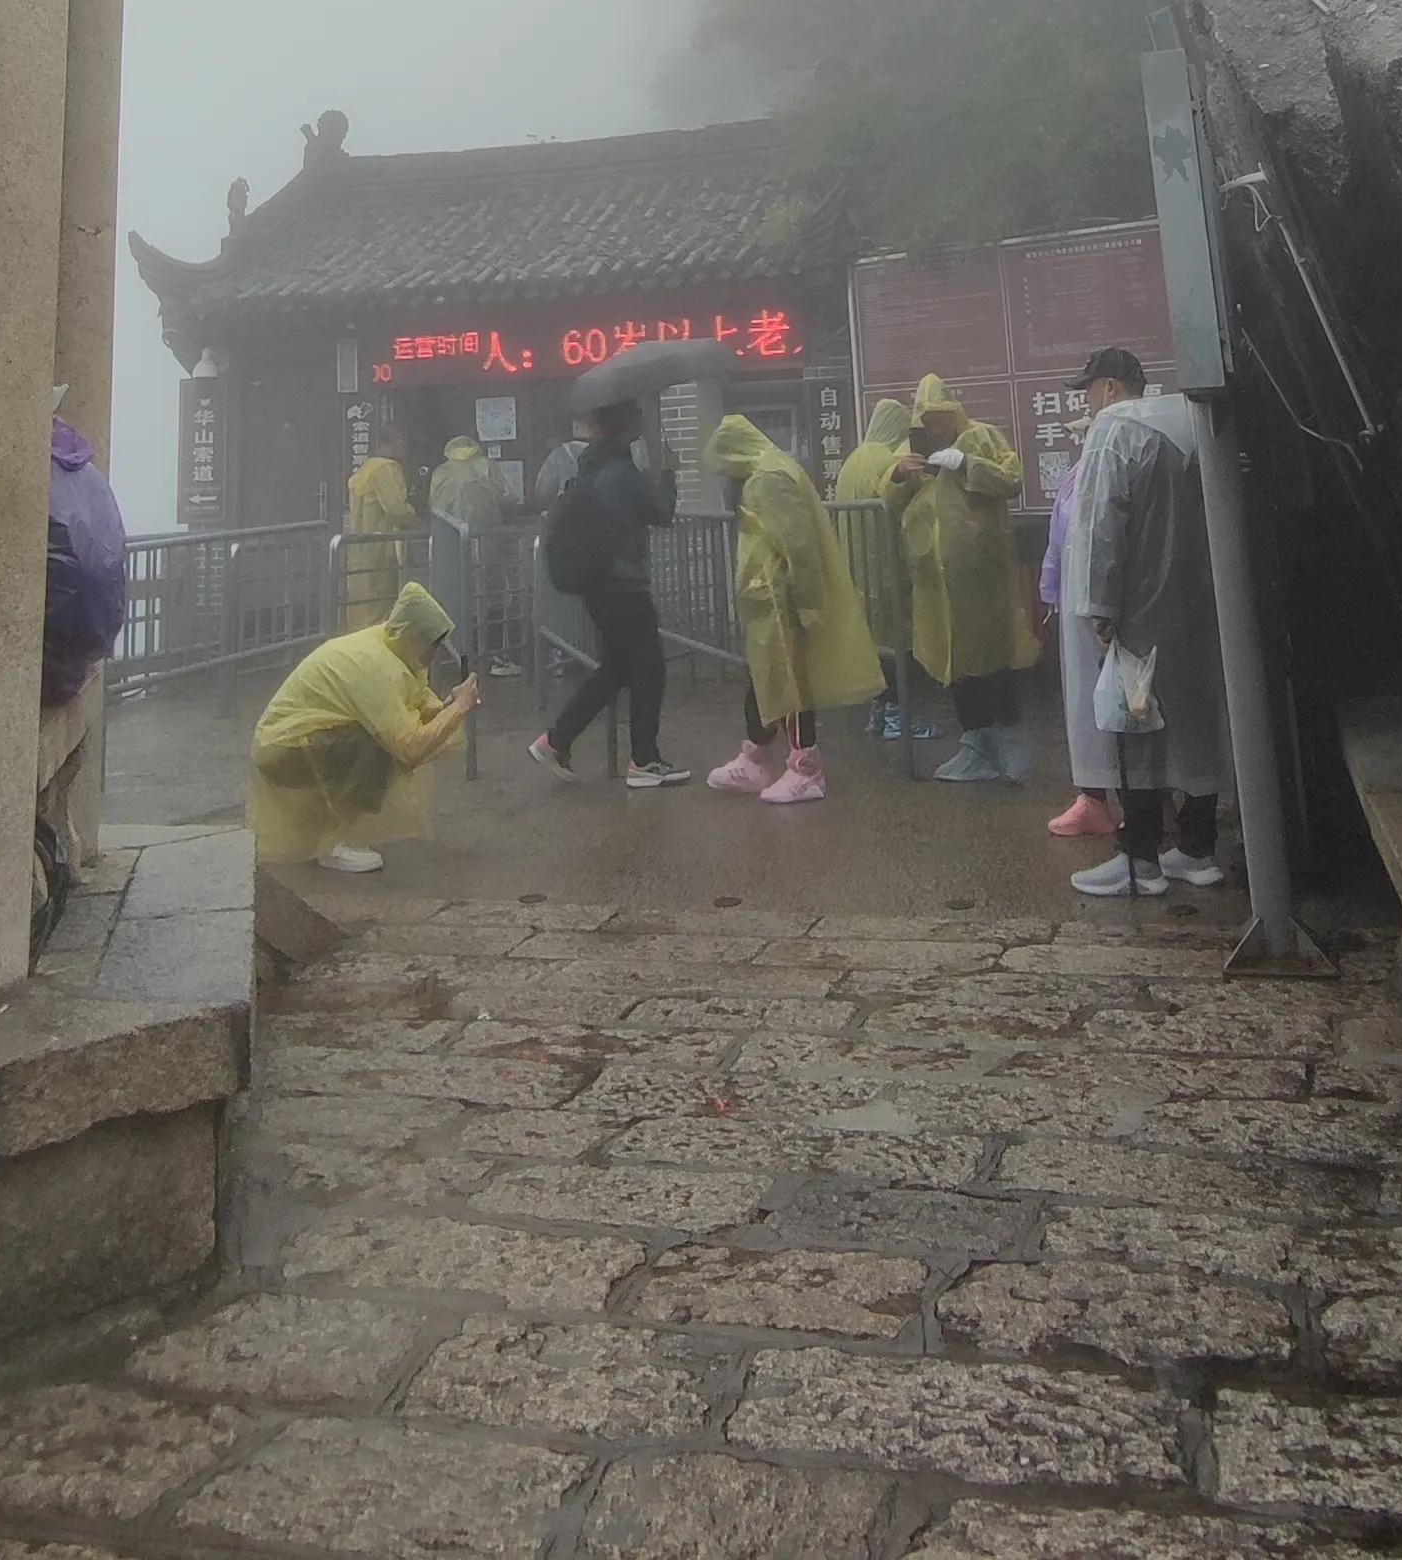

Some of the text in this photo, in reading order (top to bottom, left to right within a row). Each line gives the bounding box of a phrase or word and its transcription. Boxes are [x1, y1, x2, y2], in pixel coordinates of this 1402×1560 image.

[393, 331, 479, 361] 运营时间
[192, 409, 216, 483] 华山索道
[351, 421, 370, 474] 索道售票
